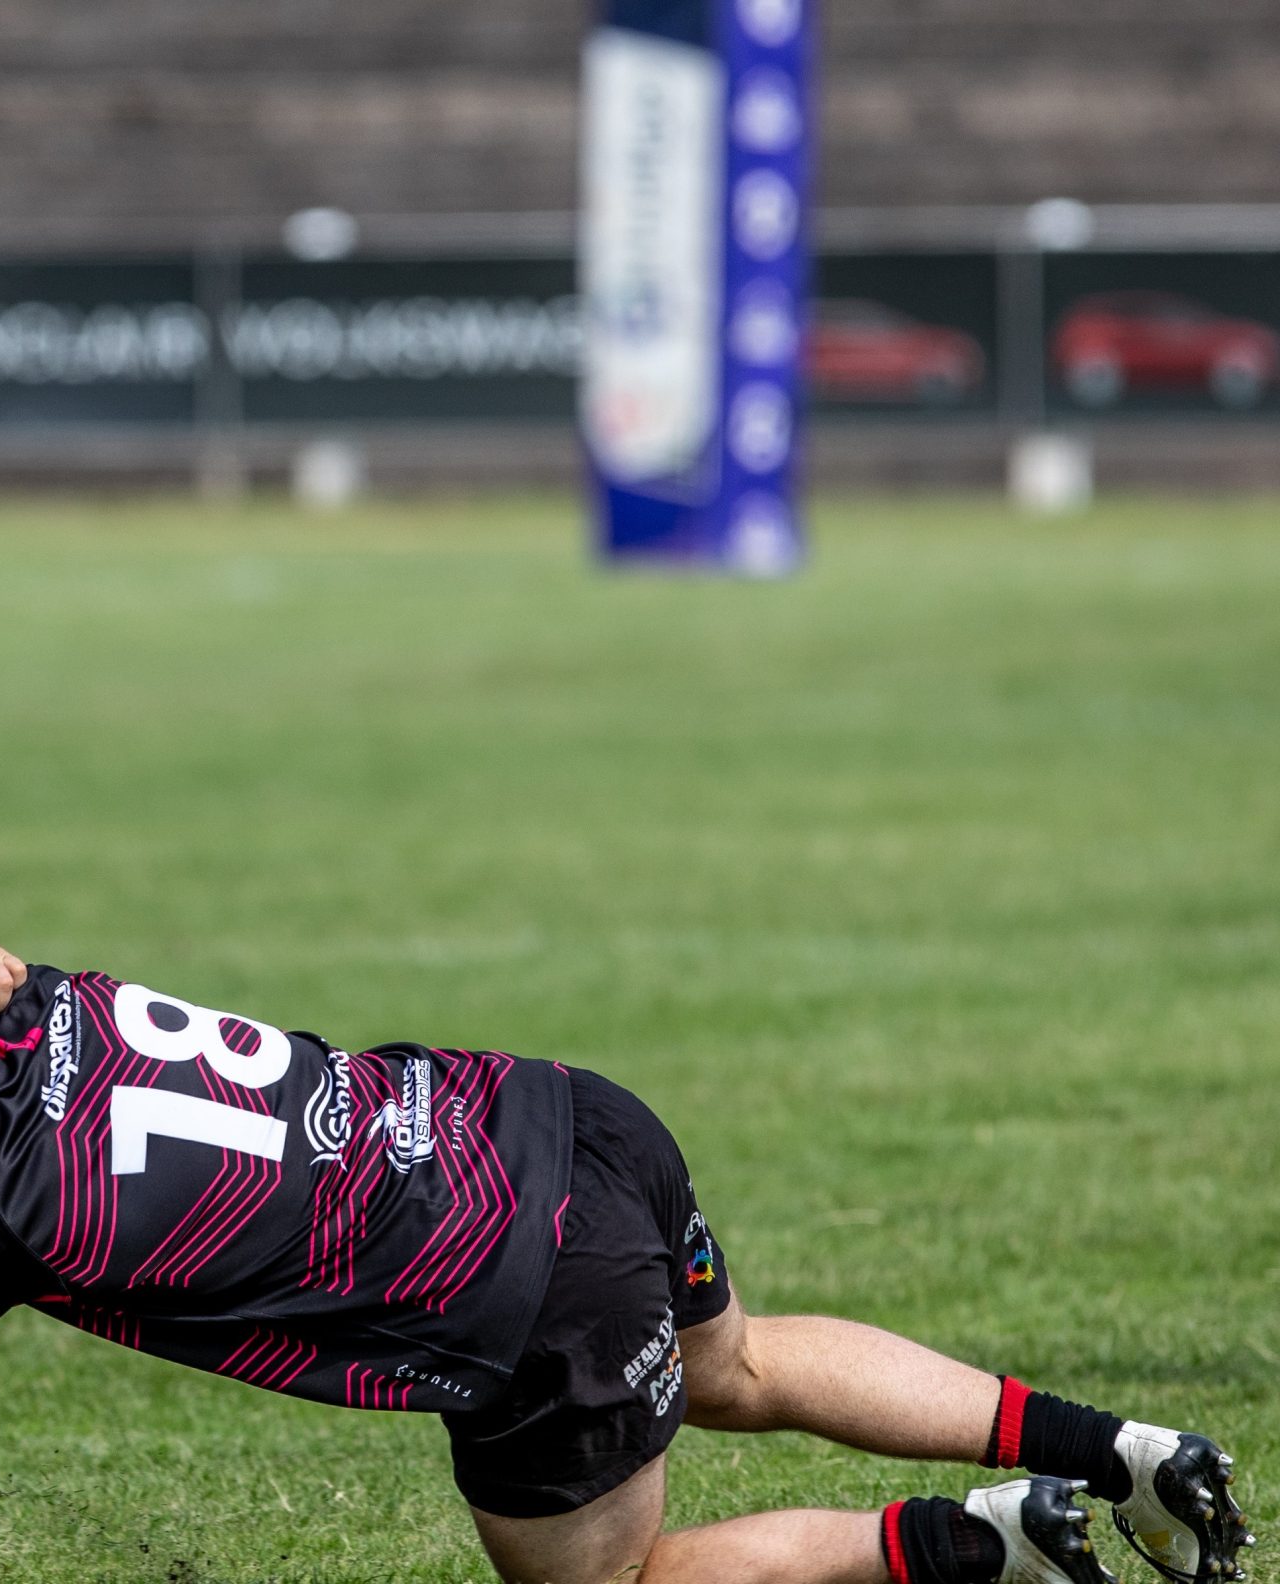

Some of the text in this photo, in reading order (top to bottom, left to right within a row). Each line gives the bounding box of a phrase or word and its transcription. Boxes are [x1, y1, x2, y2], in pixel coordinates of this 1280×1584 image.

[41, 999, 79, 1121] allspares
[110, 983, 291, 1176] 18
[623, 1337, 661, 1382] AFAN
